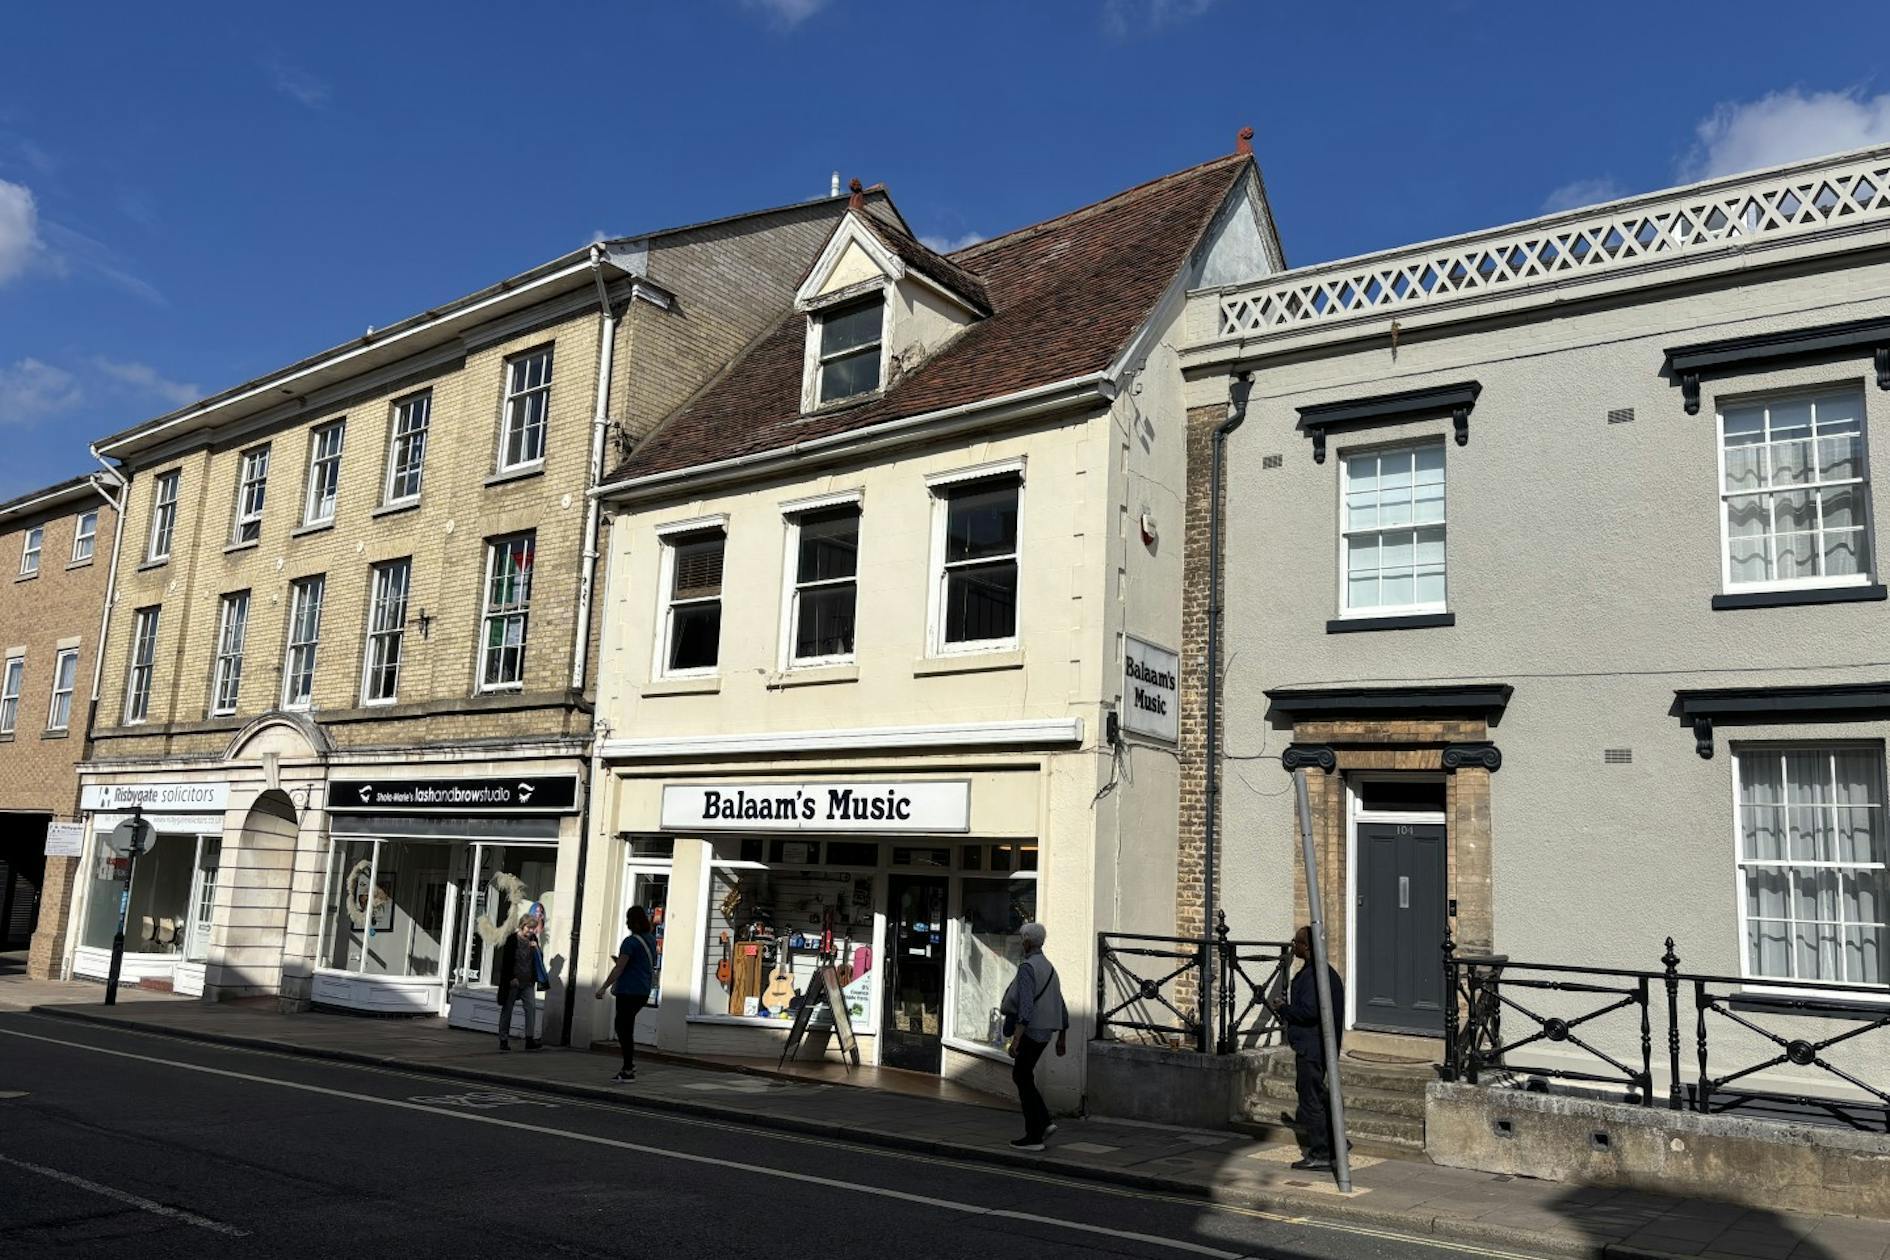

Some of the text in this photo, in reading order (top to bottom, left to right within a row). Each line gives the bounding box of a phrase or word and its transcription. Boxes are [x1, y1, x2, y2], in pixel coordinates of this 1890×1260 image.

[1126, 656, 1175, 690] Balaam's
[1134, 687, 1167, 715] Music
[114, 786, 215, 806] Risbygate solicitors
[702, 789, 911, 820] Balaam's Music
[1396, 825, 1414, 835] 104
